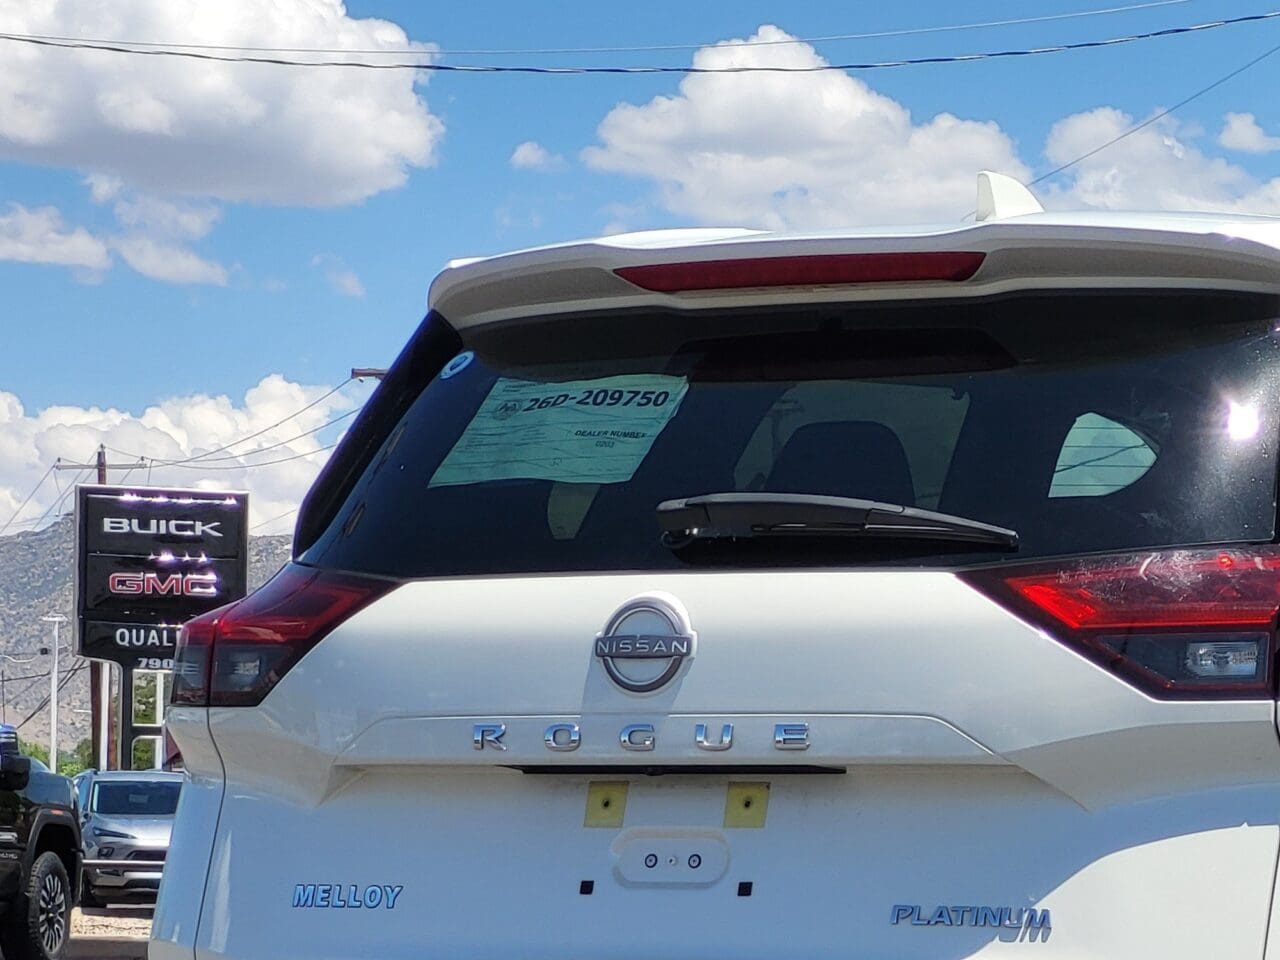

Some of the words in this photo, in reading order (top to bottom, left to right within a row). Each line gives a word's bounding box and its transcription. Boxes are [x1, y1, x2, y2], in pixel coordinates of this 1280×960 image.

[103, 517, 223, 537] BUICK
[109, 571, 217, 596] GMC
[597, 640, 687, 653] NISSAN
[473, 722, 811, 753] ROGUE
[292, 883, 404, 909] MELLOY
[889, 904, 1052, 929] PLATINUM
